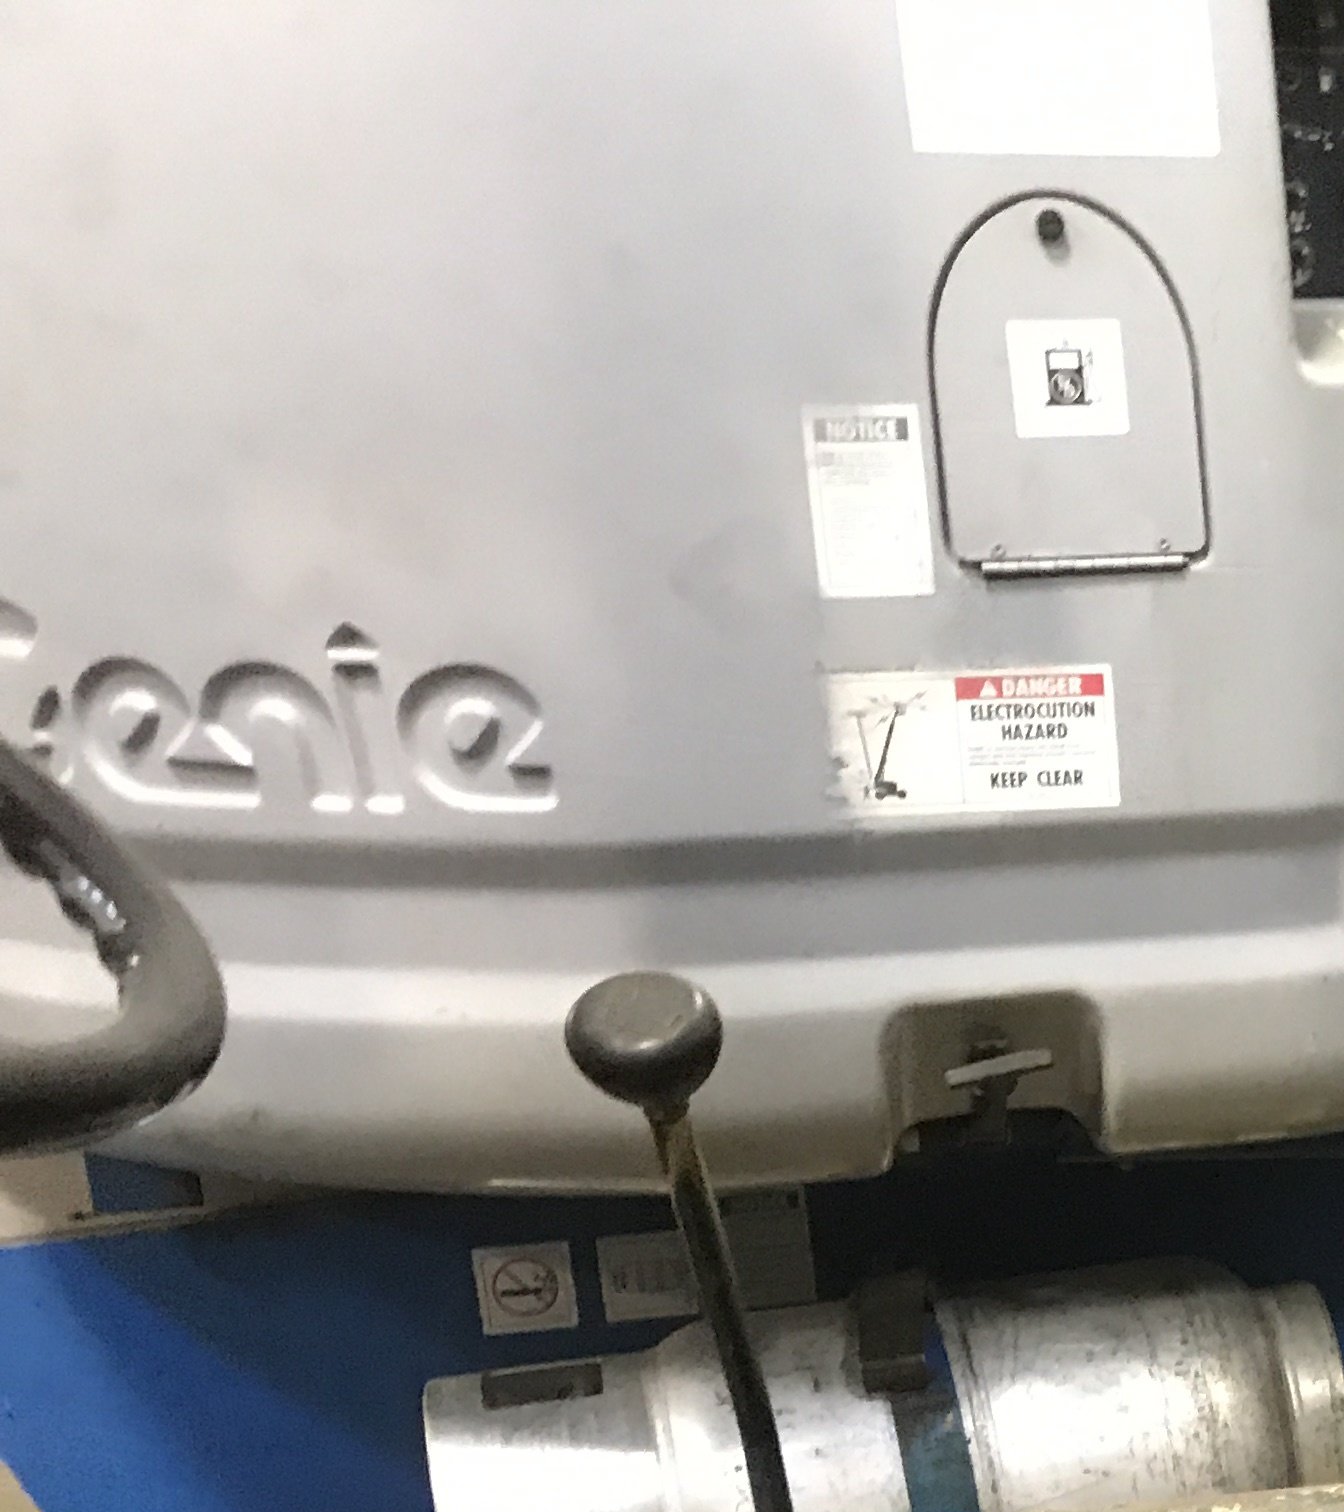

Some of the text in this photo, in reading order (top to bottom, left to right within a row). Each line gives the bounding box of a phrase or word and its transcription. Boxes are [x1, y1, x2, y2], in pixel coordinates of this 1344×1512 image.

[1002, 677, 1082, 697] DANGER
[970, 702, 1096, 721] ELECTROCUTION
[1001, 723, 1068, 741] HAZARD
[990, 769, 1084, 789] KEEP CLEAR
